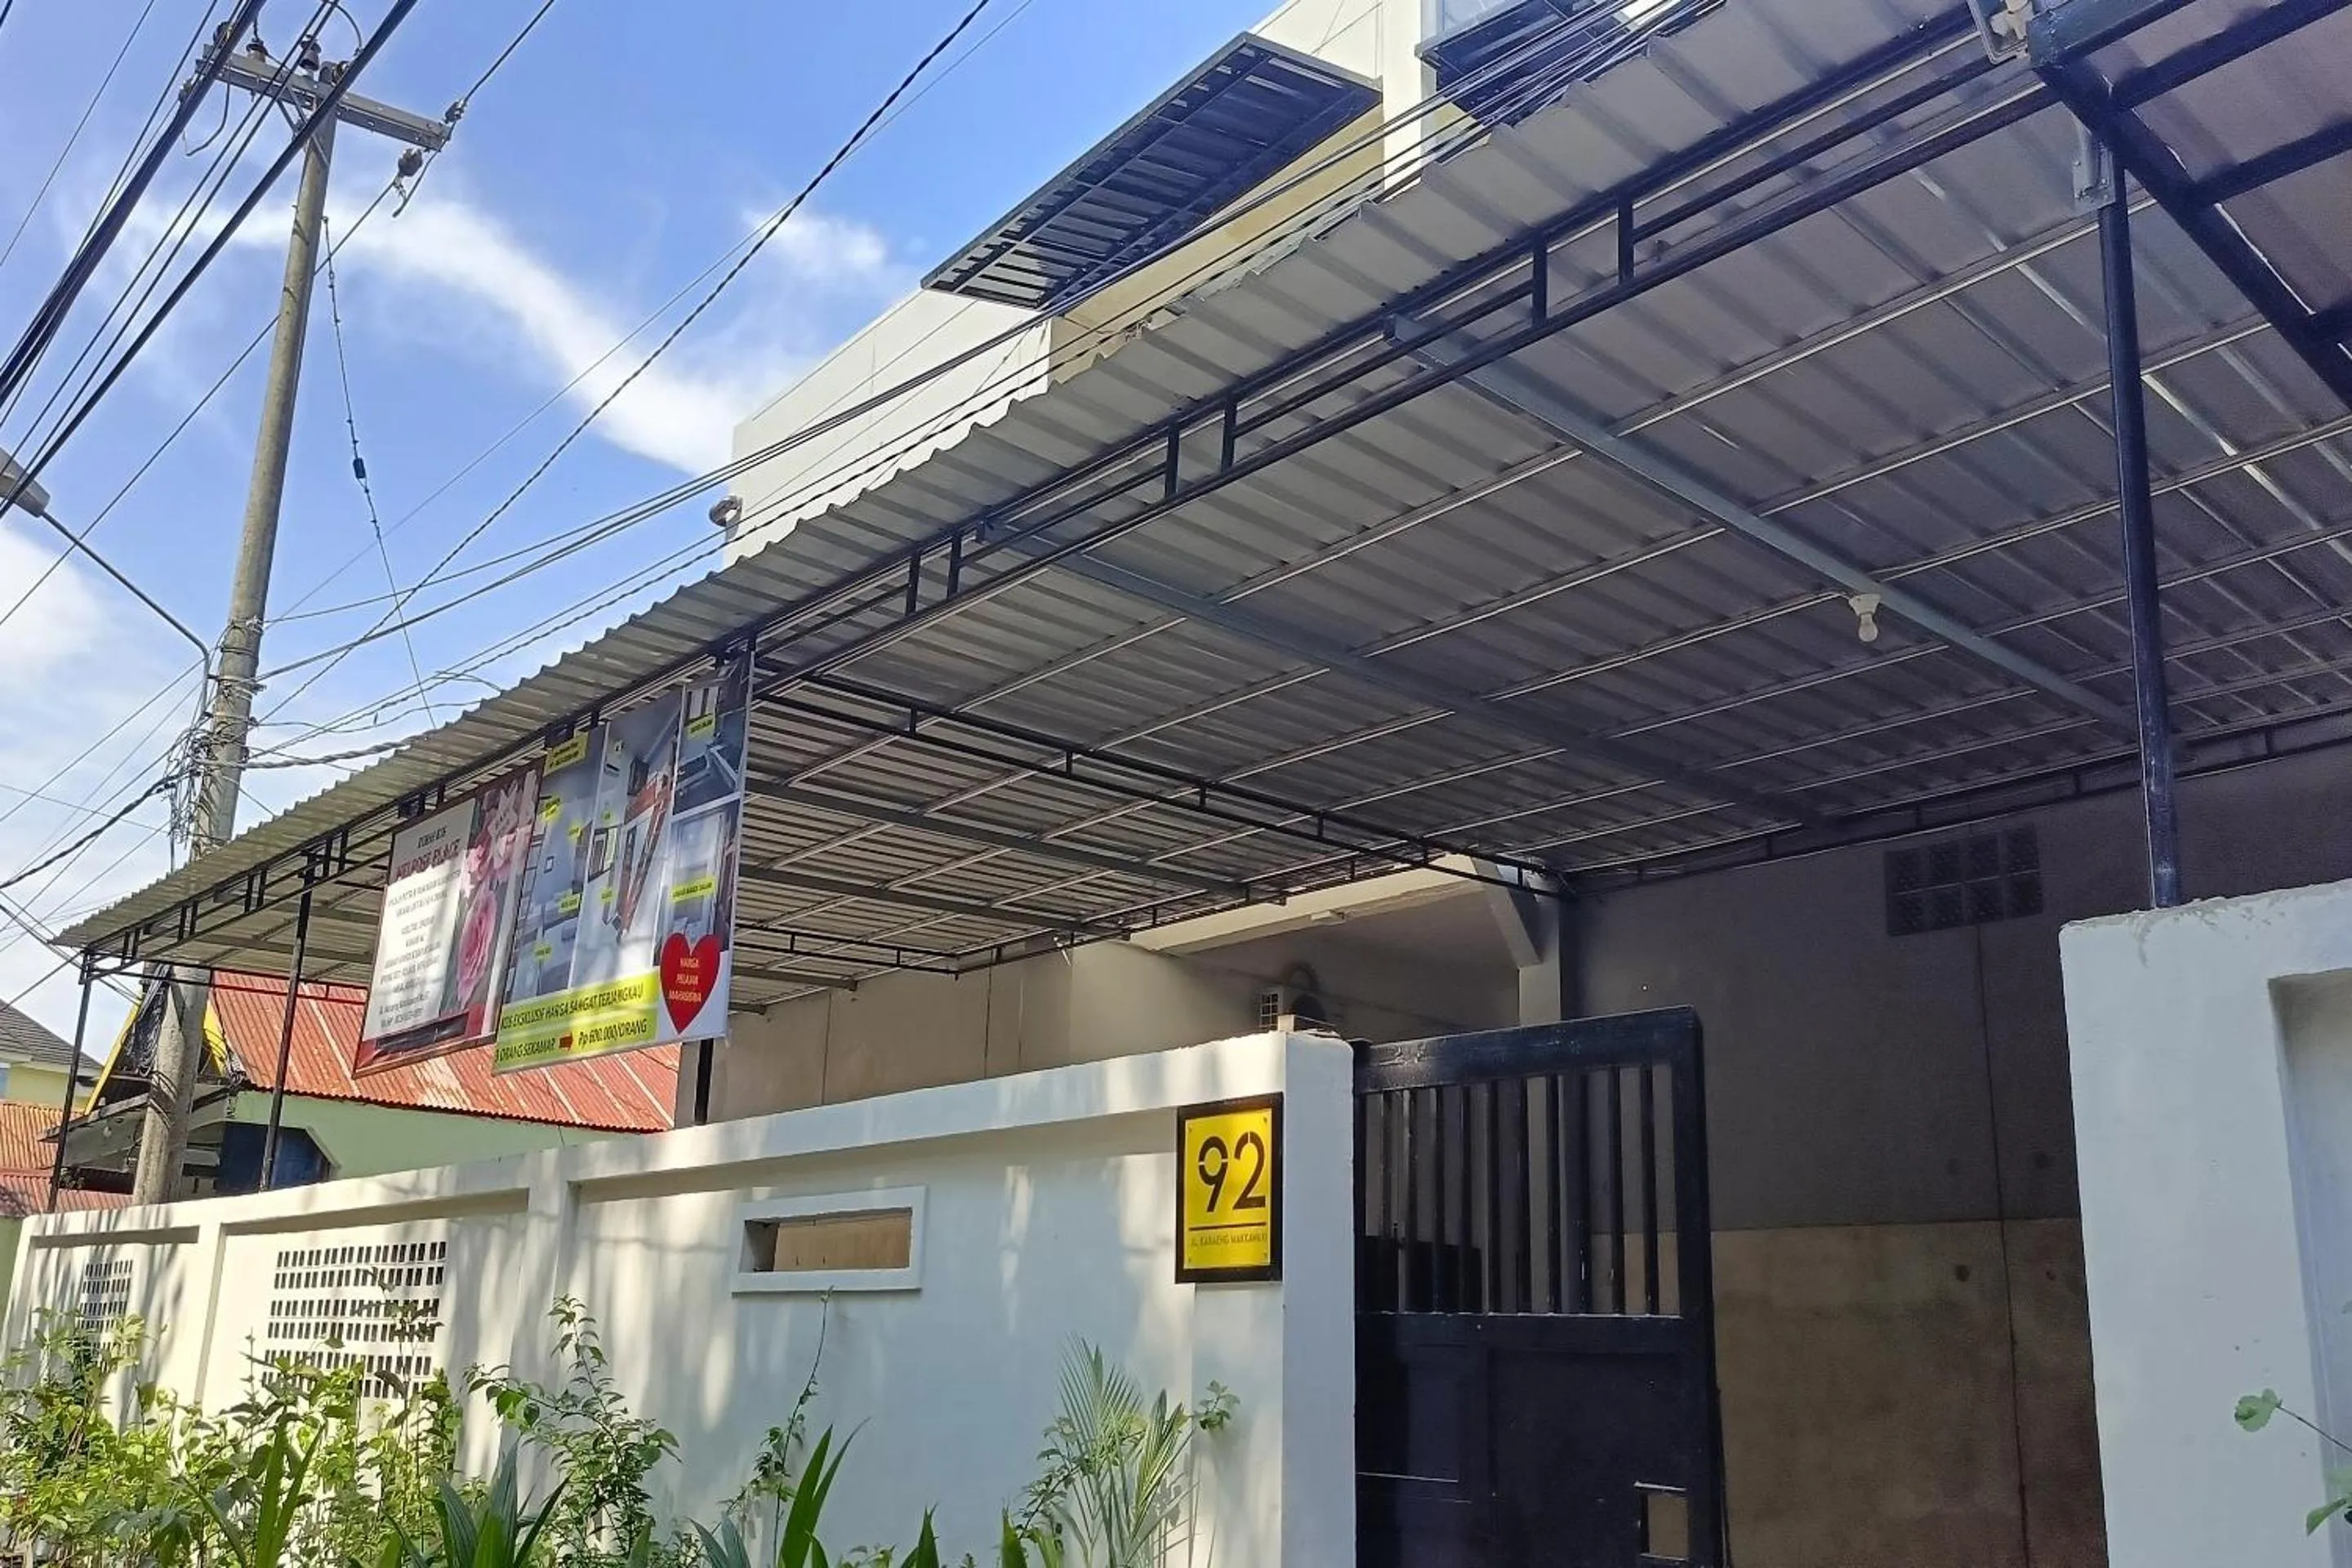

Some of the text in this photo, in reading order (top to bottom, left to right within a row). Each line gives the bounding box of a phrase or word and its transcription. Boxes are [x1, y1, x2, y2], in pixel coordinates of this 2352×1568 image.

[679, 957, 700, 969] HARGA
[544, 1004, 569, 1020] HARGA
[568, 994, 599, 1014] SANGAT
[597, 982, 644, 1008] TERJANGKAU
[522, 1037, 556, 1057] SEKAMAR
[1197, 1130, 1267, 1213] 92
